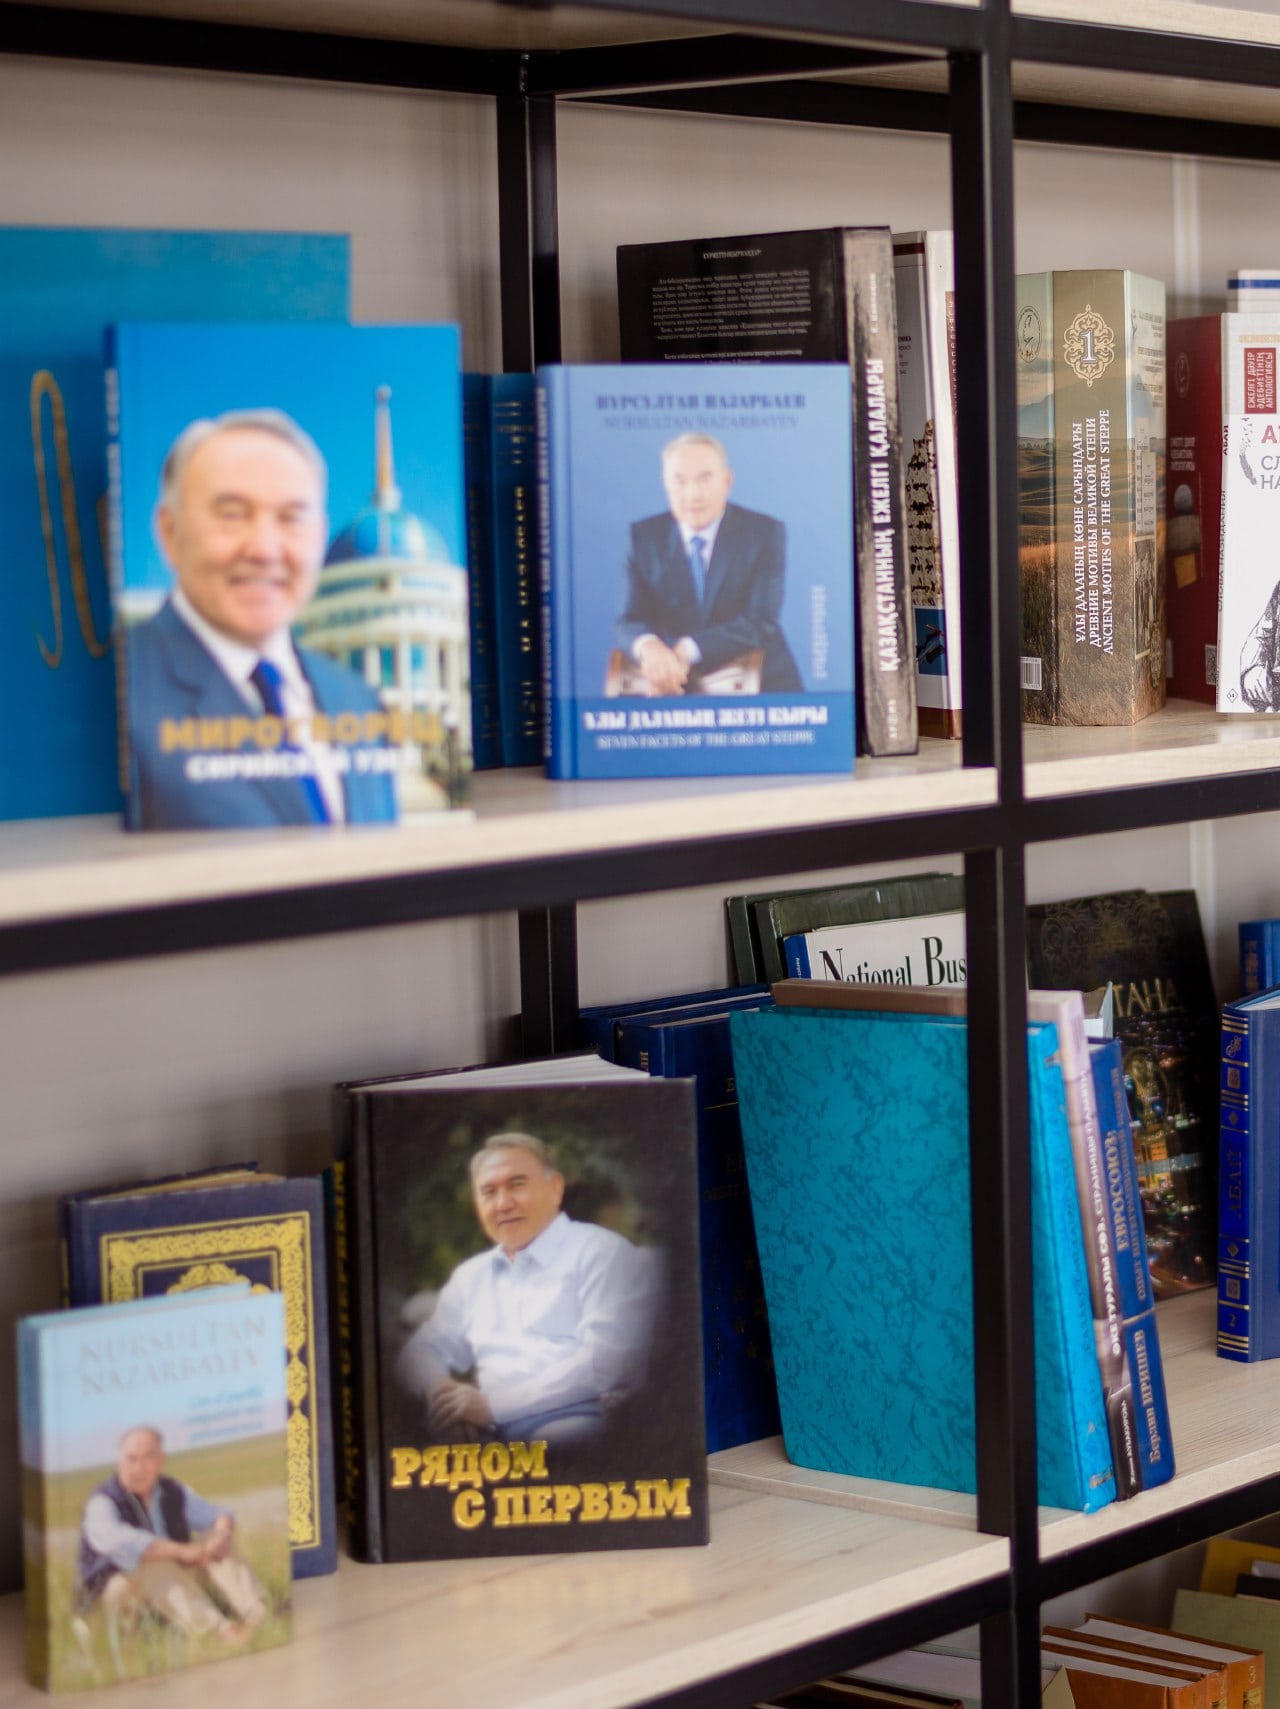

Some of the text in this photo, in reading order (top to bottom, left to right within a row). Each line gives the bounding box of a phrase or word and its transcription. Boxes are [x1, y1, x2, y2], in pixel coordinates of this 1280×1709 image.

[1080, 329, 1098, 364] 1
[1247, 352, 1257, 409] ЕЖЕЛГІ ДӘУІР
[866, 359, 899, 672] ҚАЗАҚСТАННЫҢ ЕЖЕЛГІ ҚАЛАЛАРЫ
[1072, 422, 1087, 644] ҰЛЫ ДАЛАНЫҢ КӨНЕ САРЫНДАРЫ
[1084, 417, 1101, 647] ДРЕВНИЕ МОТИВЫ ВЕЛИКОЙ СТЕПИ
[1098, 409, 1114, 655] ANCIENT MOTIFS OF THE GREAT STEPPE
[159, 706, 443, 754] МИРОТВОРЕЦ
[1103, 1130, 1127, 1252] ЕВРОСОЮЗ:
[1133, 1328, 1162, 1463] Берлин ИРИШЕВ
[390, 1440, 549, 1491] РЯДОМ
[453, 1477, 692, 1530] С ПЕРВЫМ
